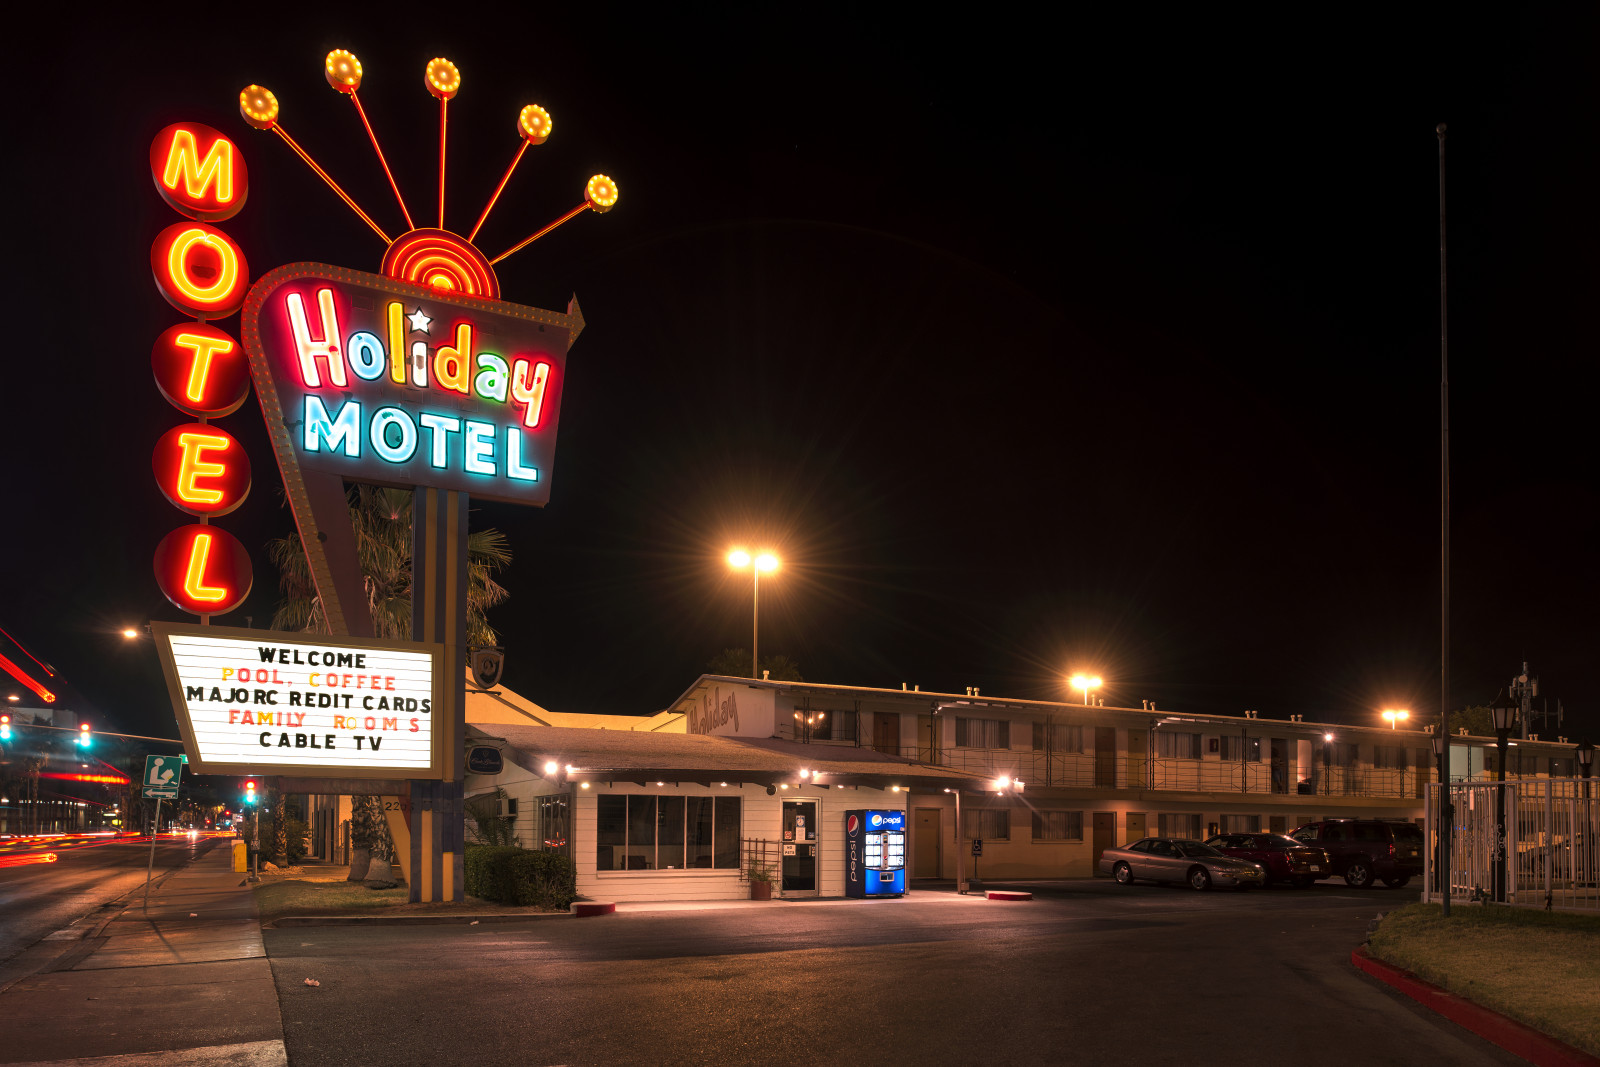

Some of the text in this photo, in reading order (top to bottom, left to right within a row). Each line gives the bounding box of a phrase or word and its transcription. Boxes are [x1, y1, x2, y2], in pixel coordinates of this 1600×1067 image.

[163, 128, 239, 602] MOTEL
[286, 288, 551, 428] Holiday
[302, 394, 539, 482] MOTEL
[258, 647, 366, 669] WELCOME
[221, 667, 396, 691] POOL, COFFEE
[362, 696, 431, 714] CARDS
[690, 686, 739, 735] Holiday
[229, 709, 420, 733] FAMILY ROOMS
[259, 732, 383, 751] CABLE TV
[882, 816, 901, 825] pepsi
[850, 840, 858, 882] pepsi
